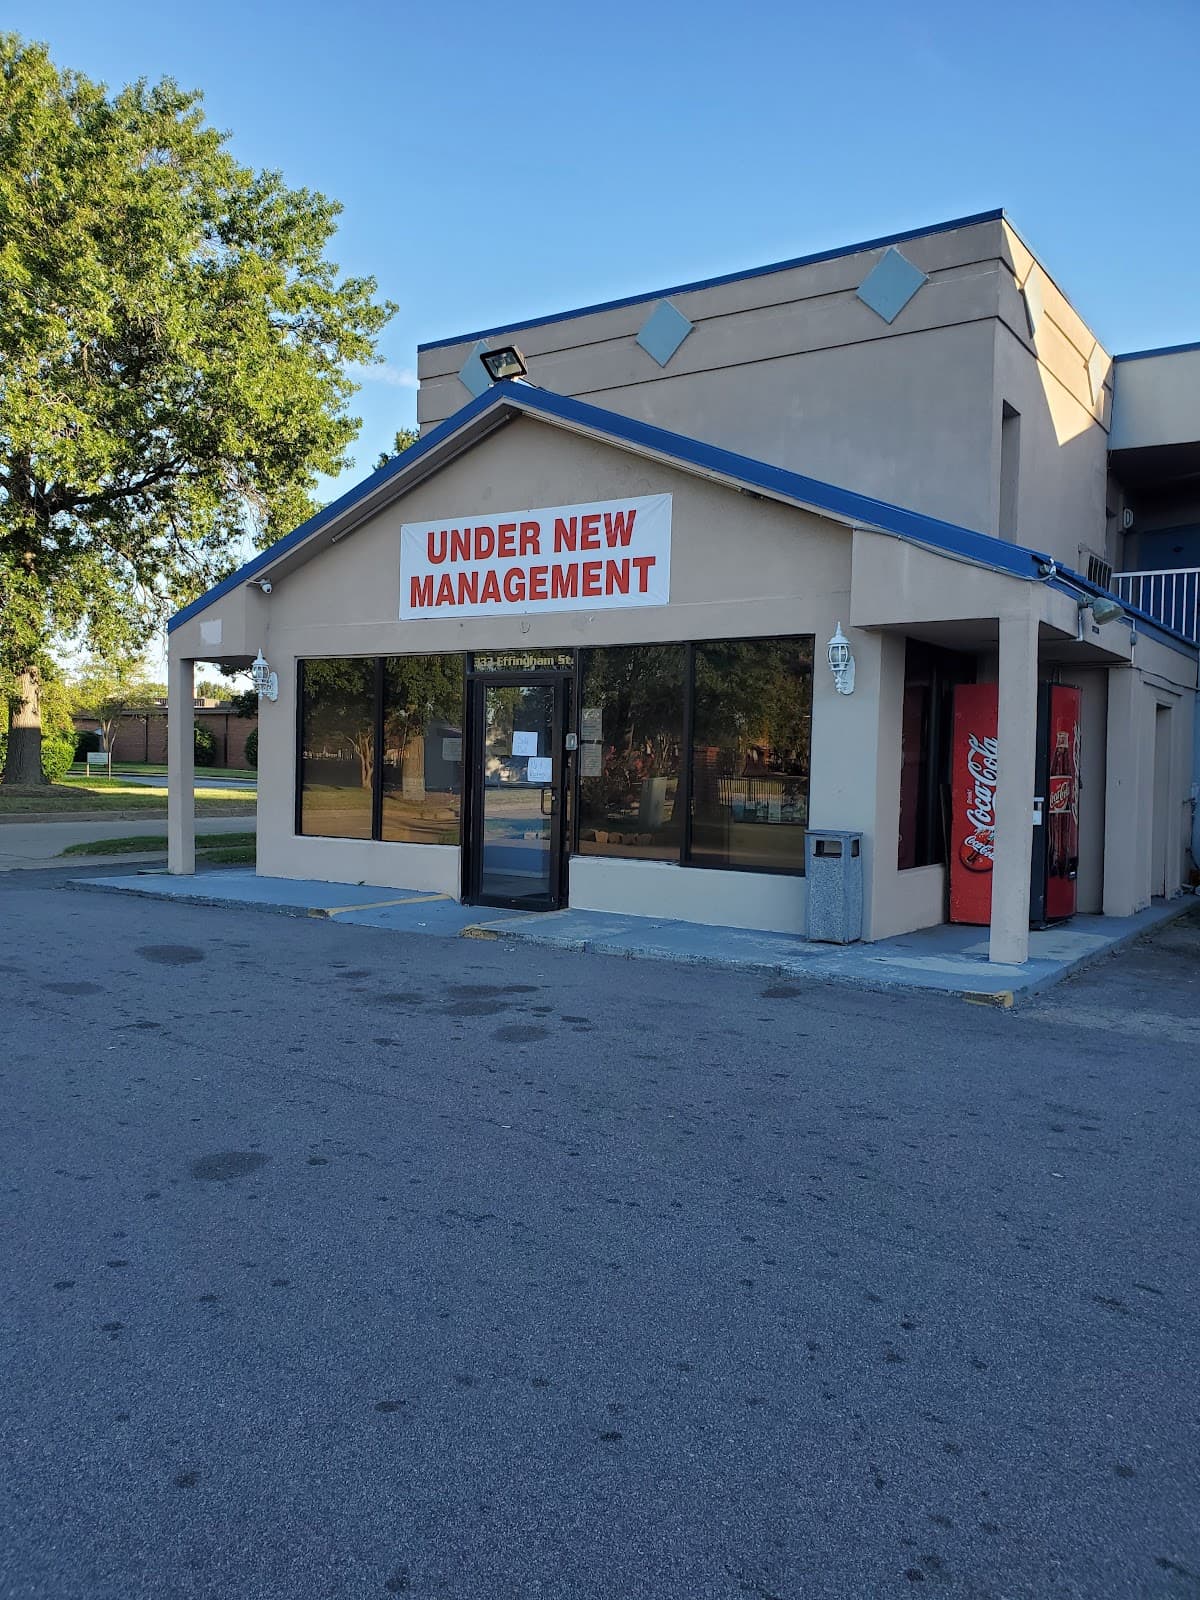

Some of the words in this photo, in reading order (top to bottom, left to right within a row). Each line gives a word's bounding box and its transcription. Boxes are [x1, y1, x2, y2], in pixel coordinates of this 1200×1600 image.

[427, 521, 541, 565] UNDER
[553, 509, 637, 553] NEW
[410, 556, 656, 608] MANAGEMENT
[496, 655, 554, 668] Effingham
